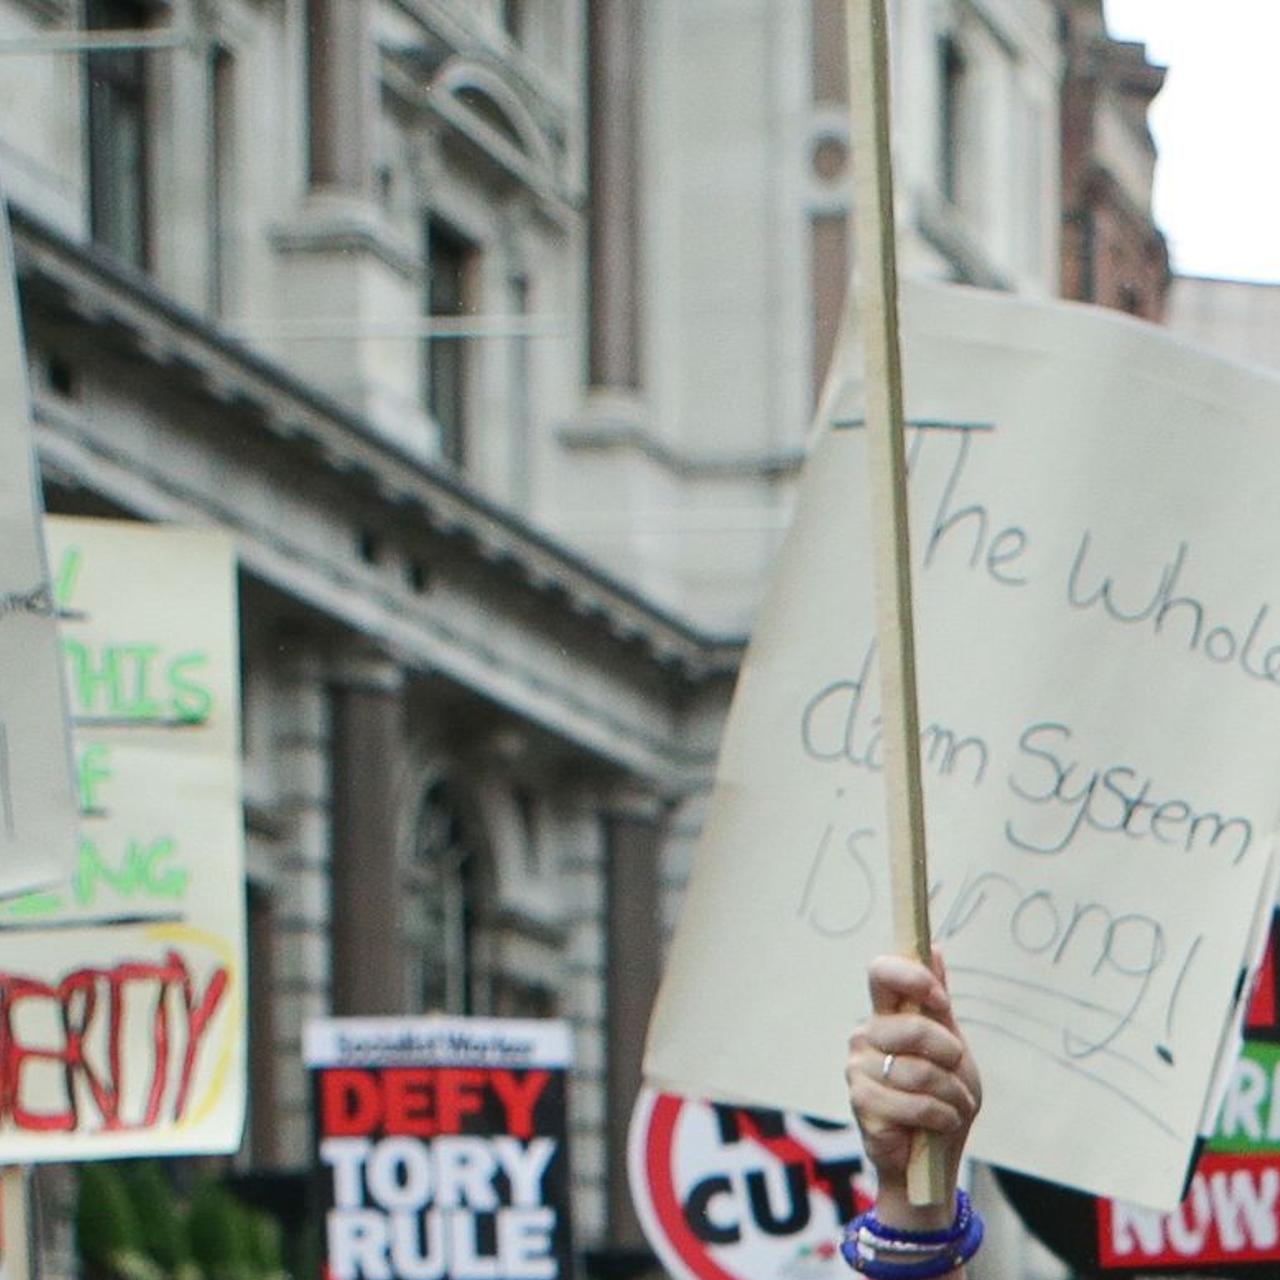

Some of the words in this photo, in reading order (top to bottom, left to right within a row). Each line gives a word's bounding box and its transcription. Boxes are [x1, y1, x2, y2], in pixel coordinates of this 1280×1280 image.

[830, 418, 1028, 588] The
[62, 640, 213, 724] HIS
[925, 858, 1204, 1065] rong!
[321, 1067, 551, 1139] DEFY
[319, 1134, 558, 1214] TORY
[684, 1158, 864, 1245] CUT
